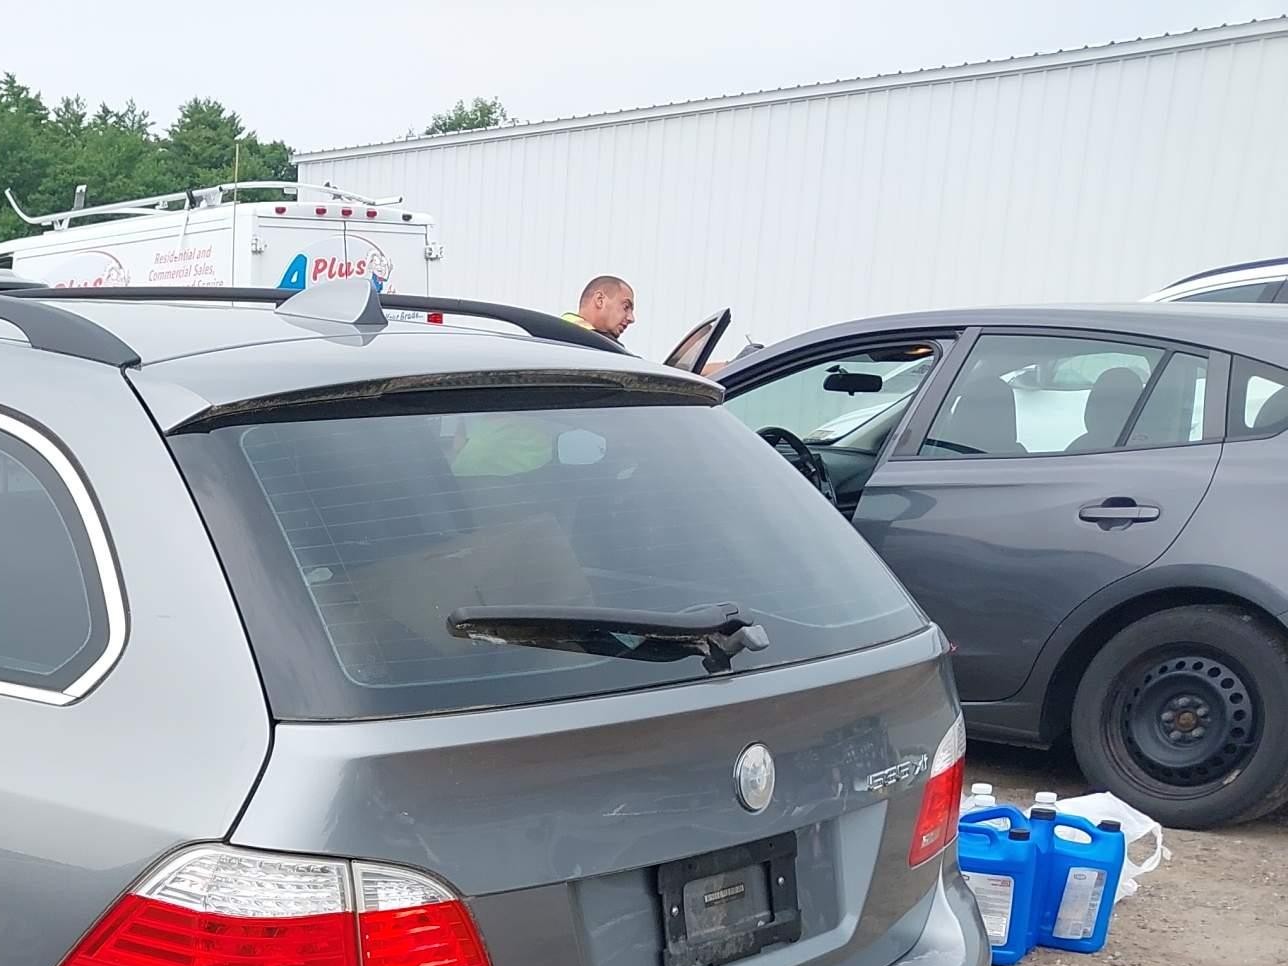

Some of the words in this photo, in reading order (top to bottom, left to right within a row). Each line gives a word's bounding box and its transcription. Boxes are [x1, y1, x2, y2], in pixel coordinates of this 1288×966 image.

[154, 247, 197, 265] Residential
[197, 244, 213, 260] and
[148, 264, 193, 282] Commercial
[193, 262, 216, 277] Sales,
[277, 253, 308, 289] A
[312, 257, 367, 281] Plus
